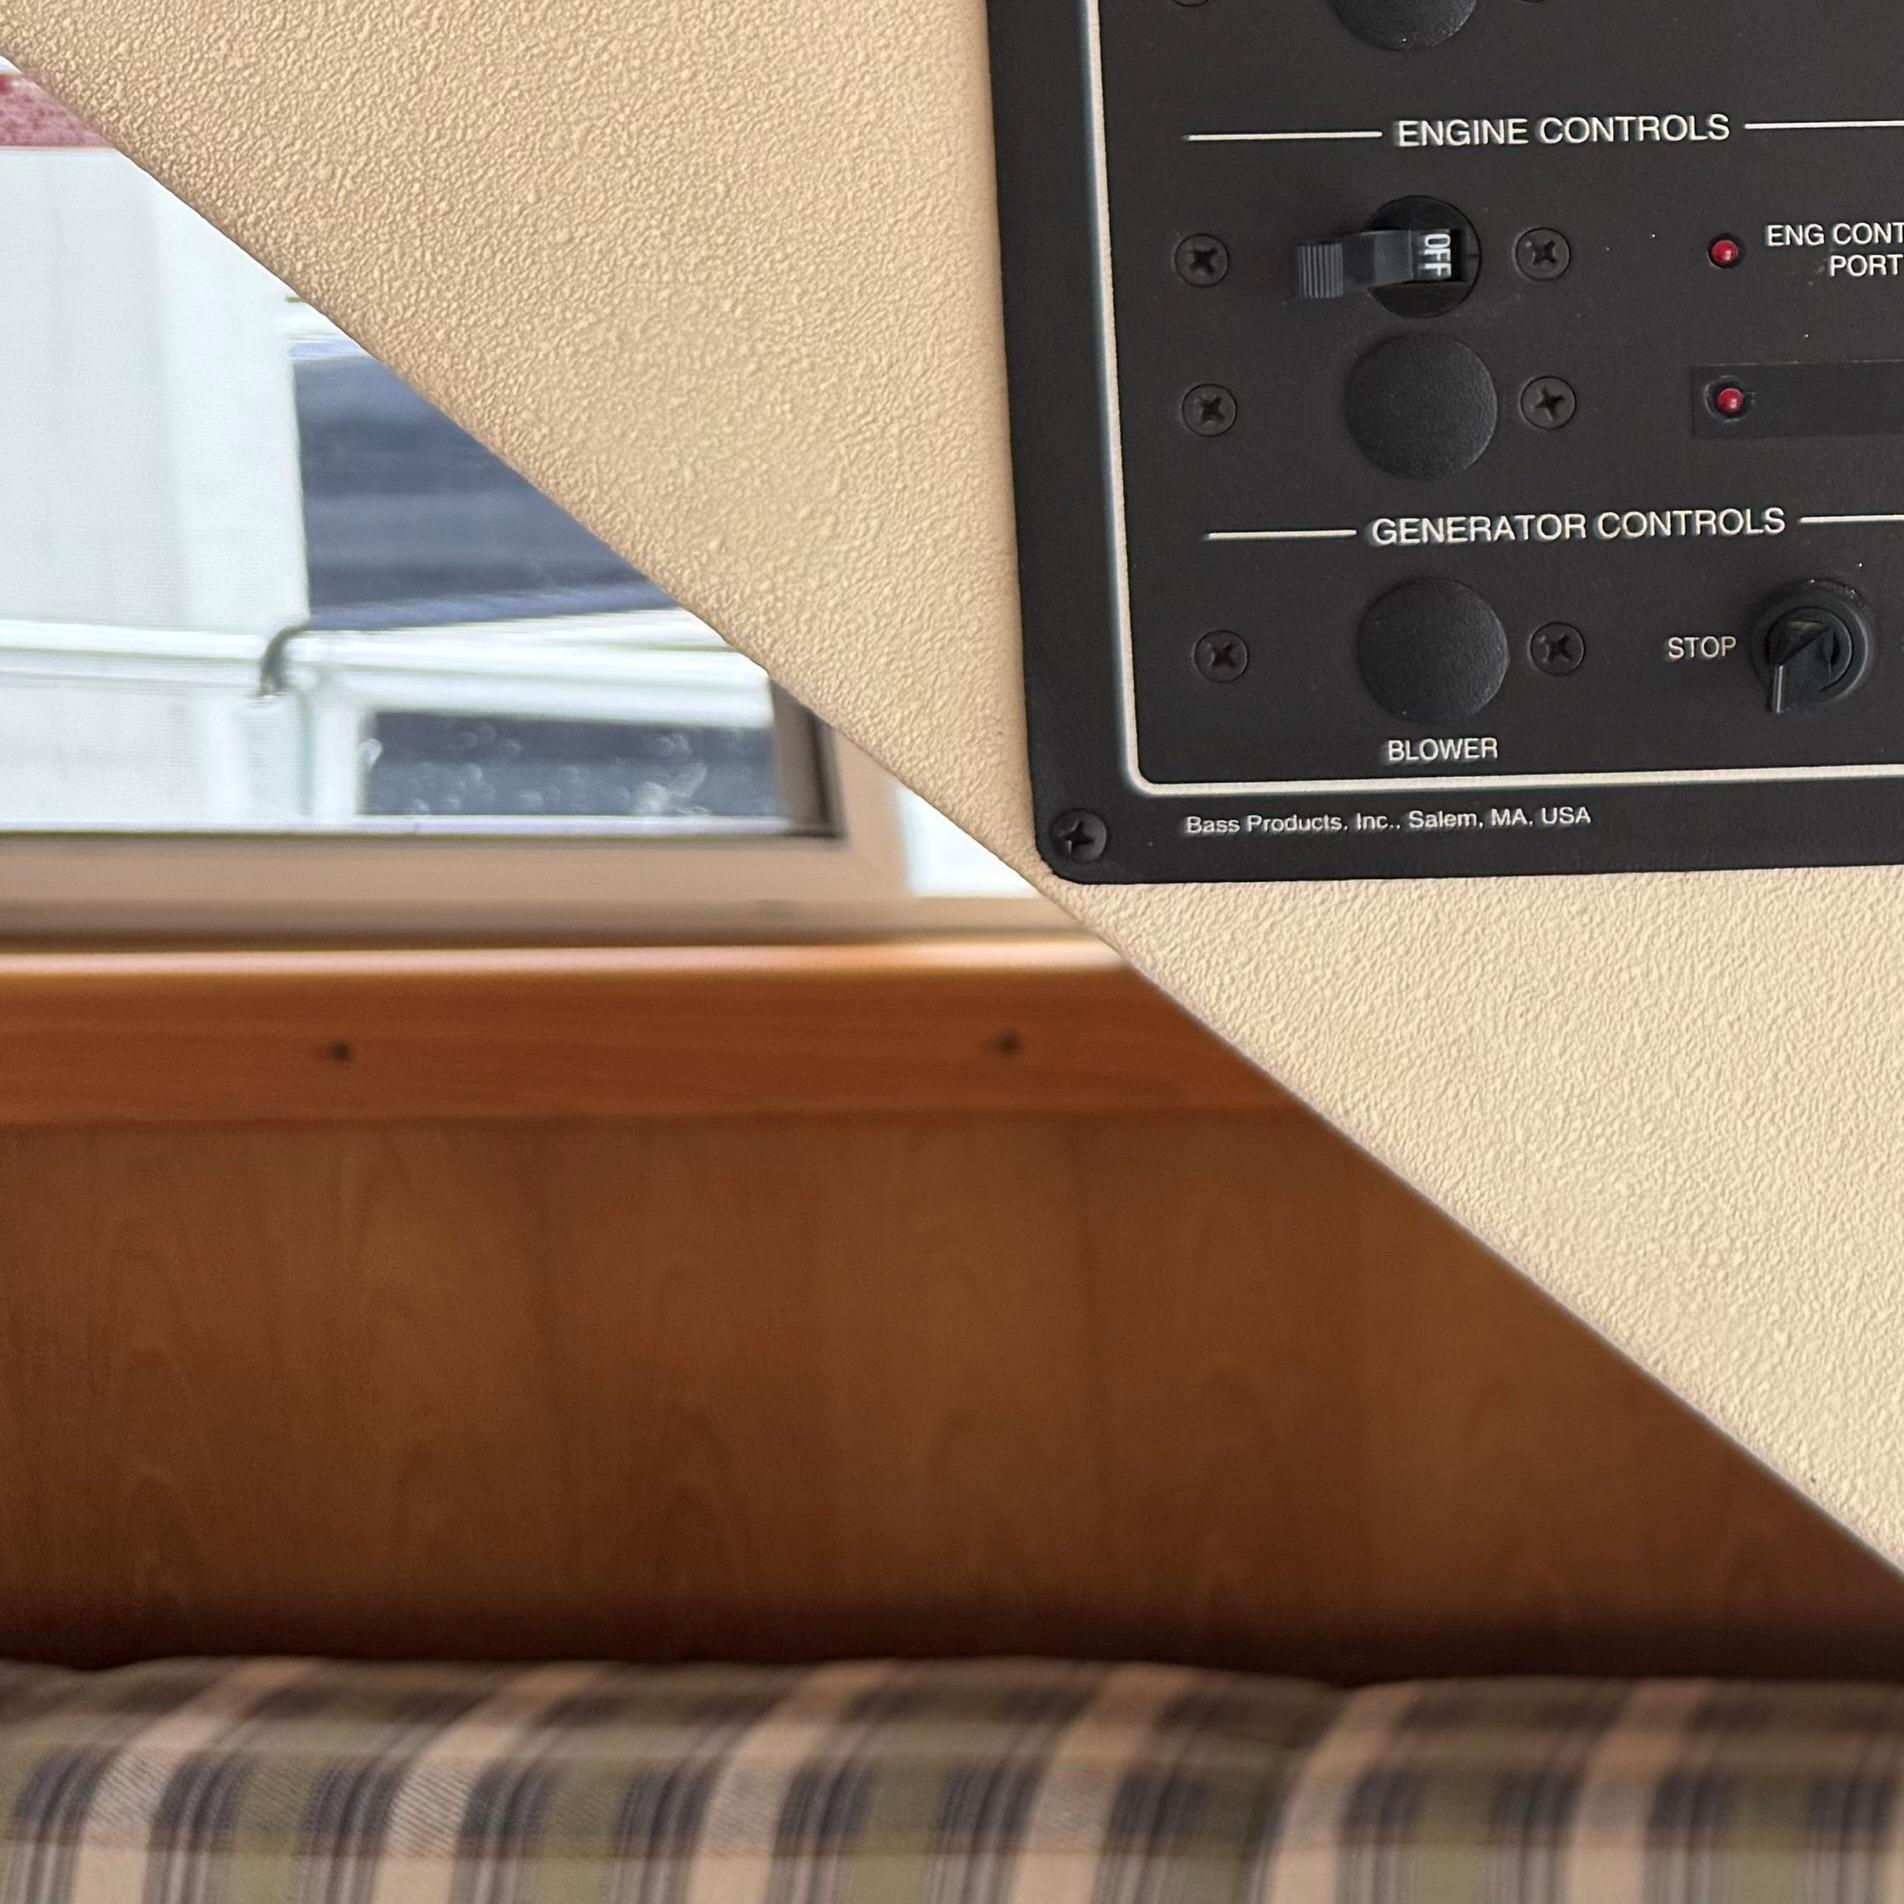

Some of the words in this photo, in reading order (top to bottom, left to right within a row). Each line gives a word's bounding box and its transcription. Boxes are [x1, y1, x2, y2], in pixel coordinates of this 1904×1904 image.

[1397, 118, 1529, 147] ENGINE
[1538, 113, 1730, 144] CONTROLS
[1371, 513, 1586, 546] GENERATOR
[1596, 507, 1786, 539] CONTROLS
[1667, 635, 1736, 660] STOP
[1387, 737, 1498, 762] BLOWER
[1185, 815, 1241, 835] Bass
[1541, 805, 1592, 825] USA
